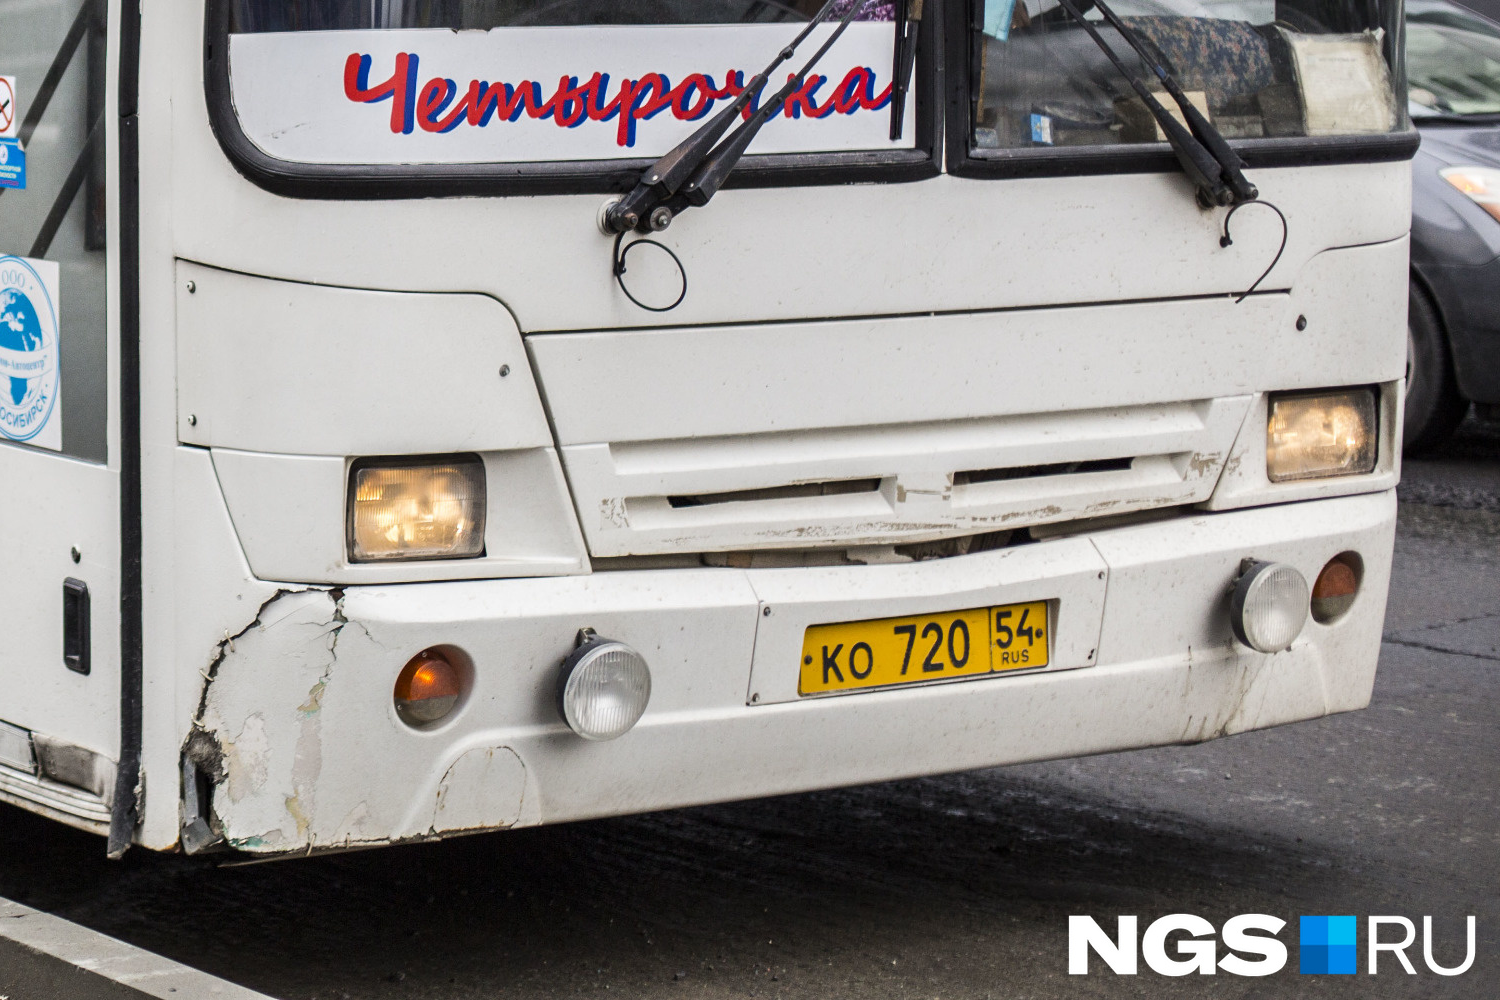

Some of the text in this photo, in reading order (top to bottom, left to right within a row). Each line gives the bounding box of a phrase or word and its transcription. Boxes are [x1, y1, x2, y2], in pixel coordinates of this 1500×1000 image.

[821, 608, 1034, 684] КО 720 54
[1002, 648, 1030, 665] RUS
